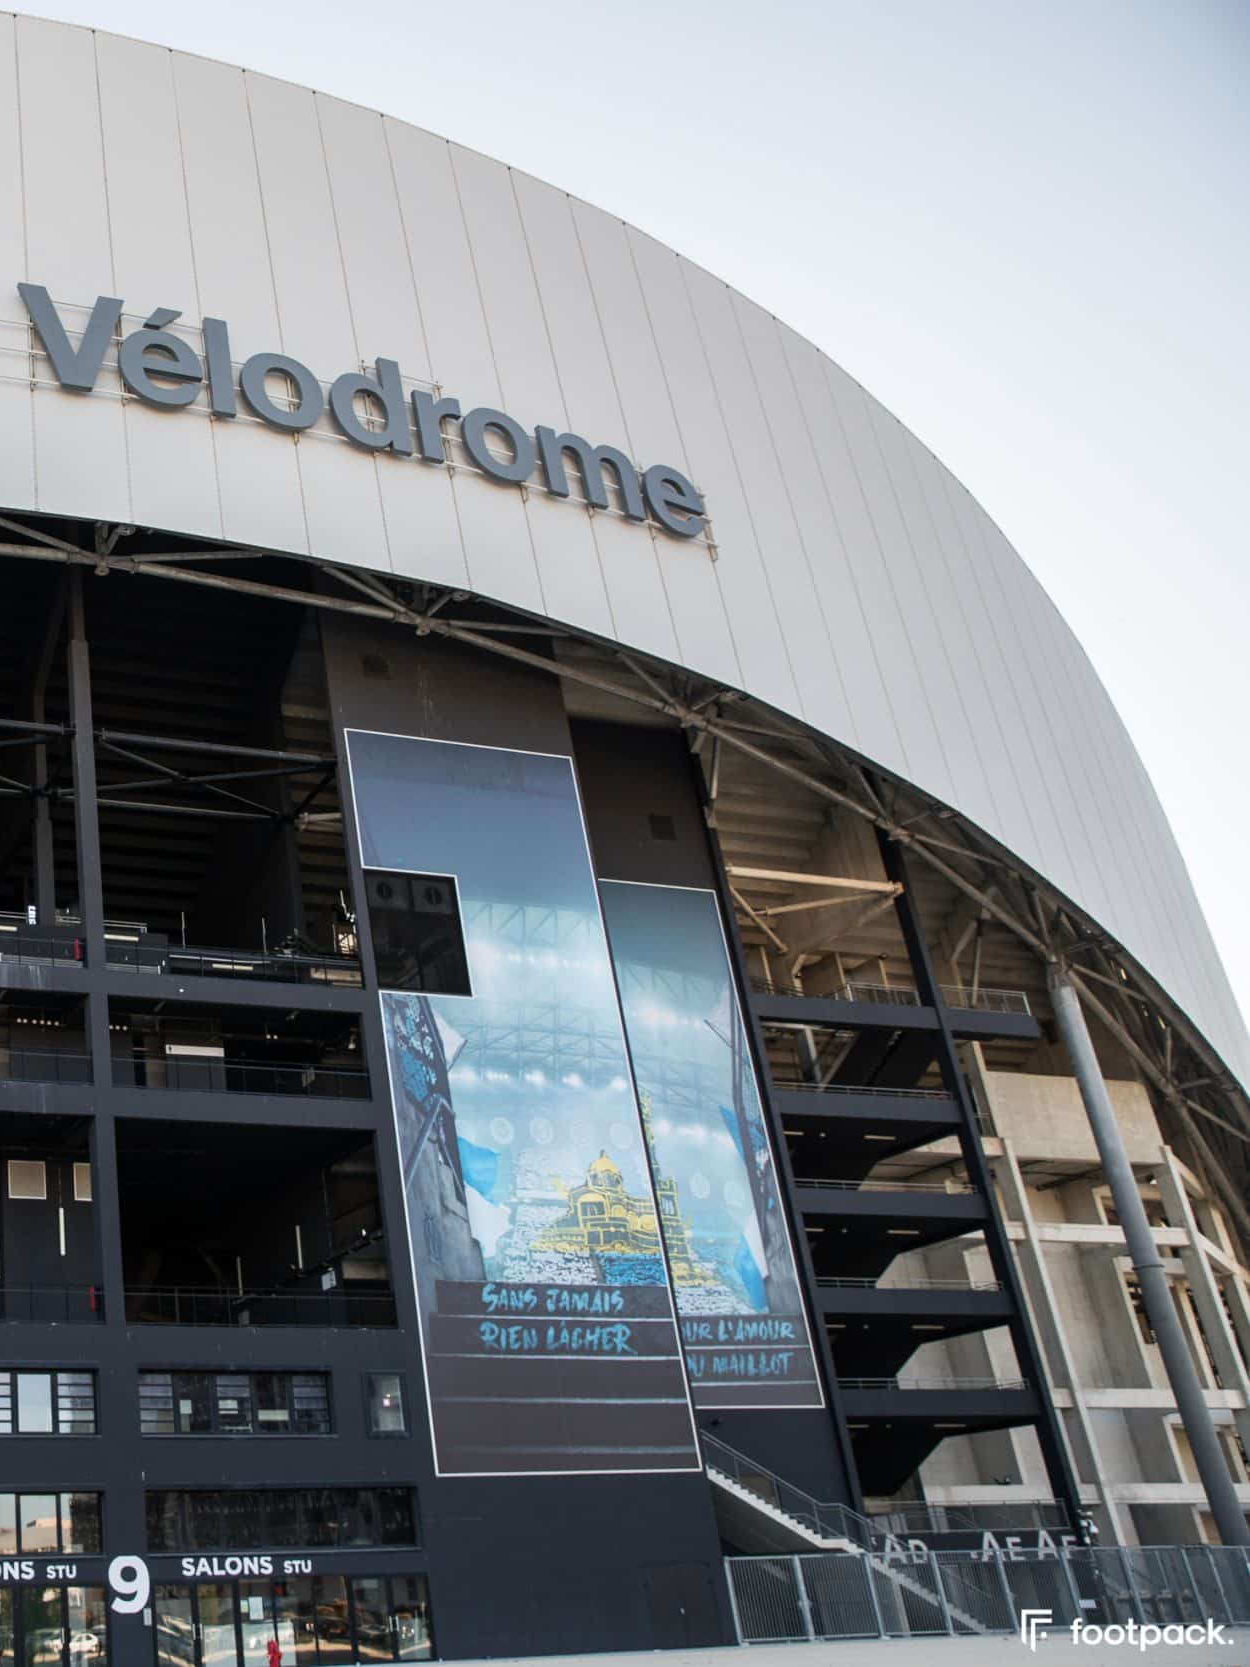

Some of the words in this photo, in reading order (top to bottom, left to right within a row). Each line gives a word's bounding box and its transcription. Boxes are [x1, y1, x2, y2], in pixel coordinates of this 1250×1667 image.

[17, 282, 706, 538] Vélodrome
[482, 1284, 538, 1312] SANS
[546, 1289, 625, 1313] JAMAIS
[479, 1321, 539, 1350] RIEN
[547, 1321, 638, 1355] LÂCHER
[717, 1319, 796, 1342] L'AMOUR
[712, 1352, 794, 1377] MAILLOT
[46, 1564, 78, 1579] STU
[181, 1556, 274, 1577] SALONS
[283, 1559, 313, 1574] STU
[108, 1554, 150, 1614] 9
